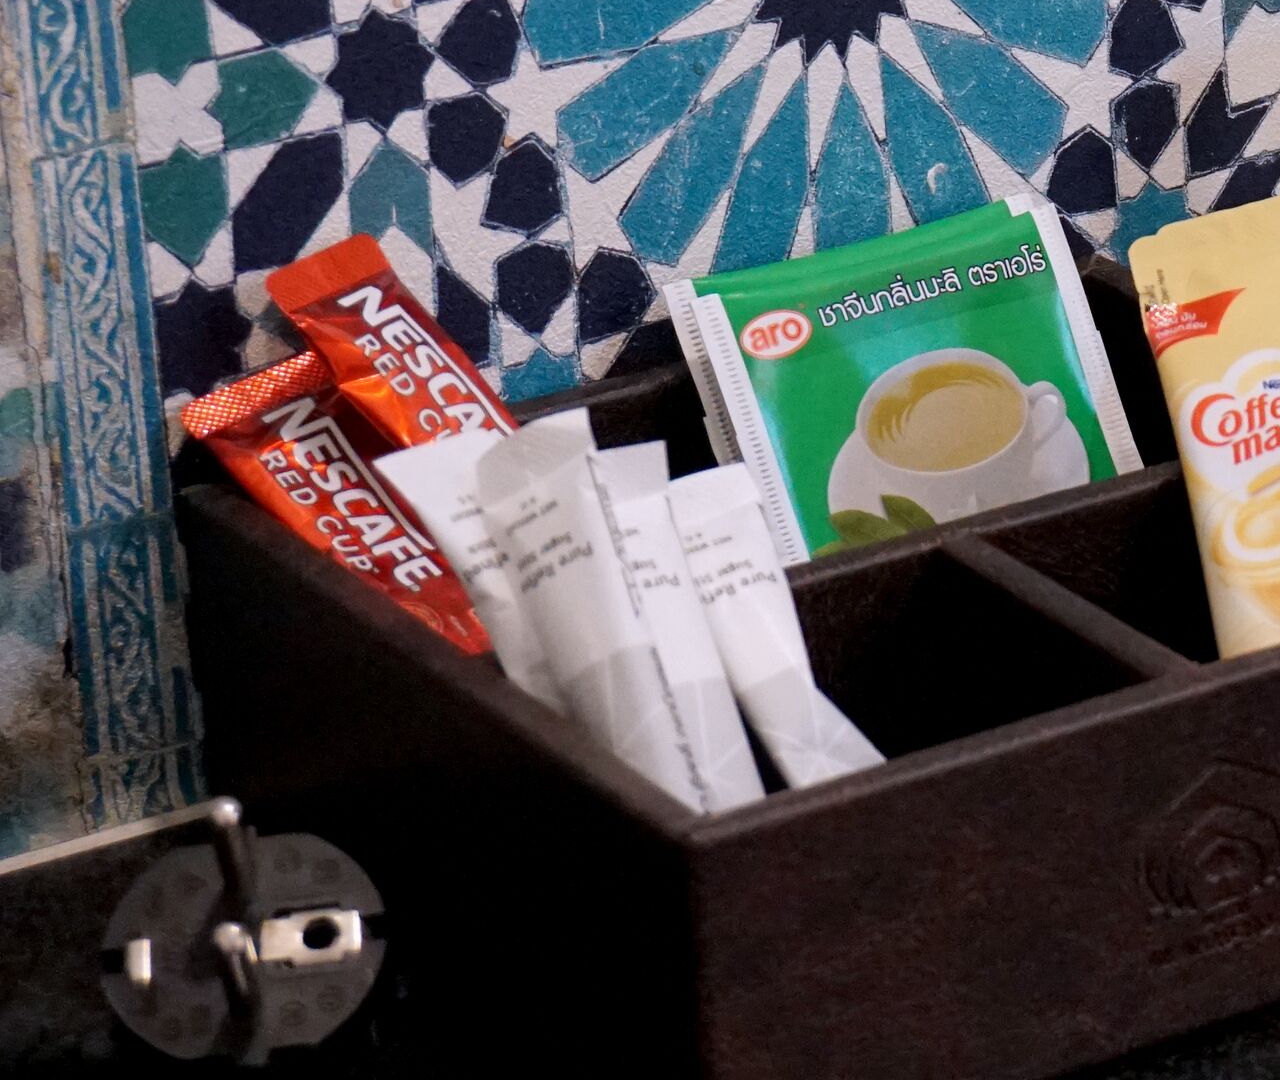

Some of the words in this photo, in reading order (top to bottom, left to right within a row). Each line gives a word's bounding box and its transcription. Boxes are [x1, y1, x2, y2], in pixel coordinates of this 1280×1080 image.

[749, 316, 803, 353] aro
[354, 333, 416, 396] RED
[259, 449, 318, 505] RED
[316, 515, 373, 570] CUP
[559, 541, 594, 567] Pure
[643, 574, 680, 589] Pure
[740, 571, 777, 587] Pure
